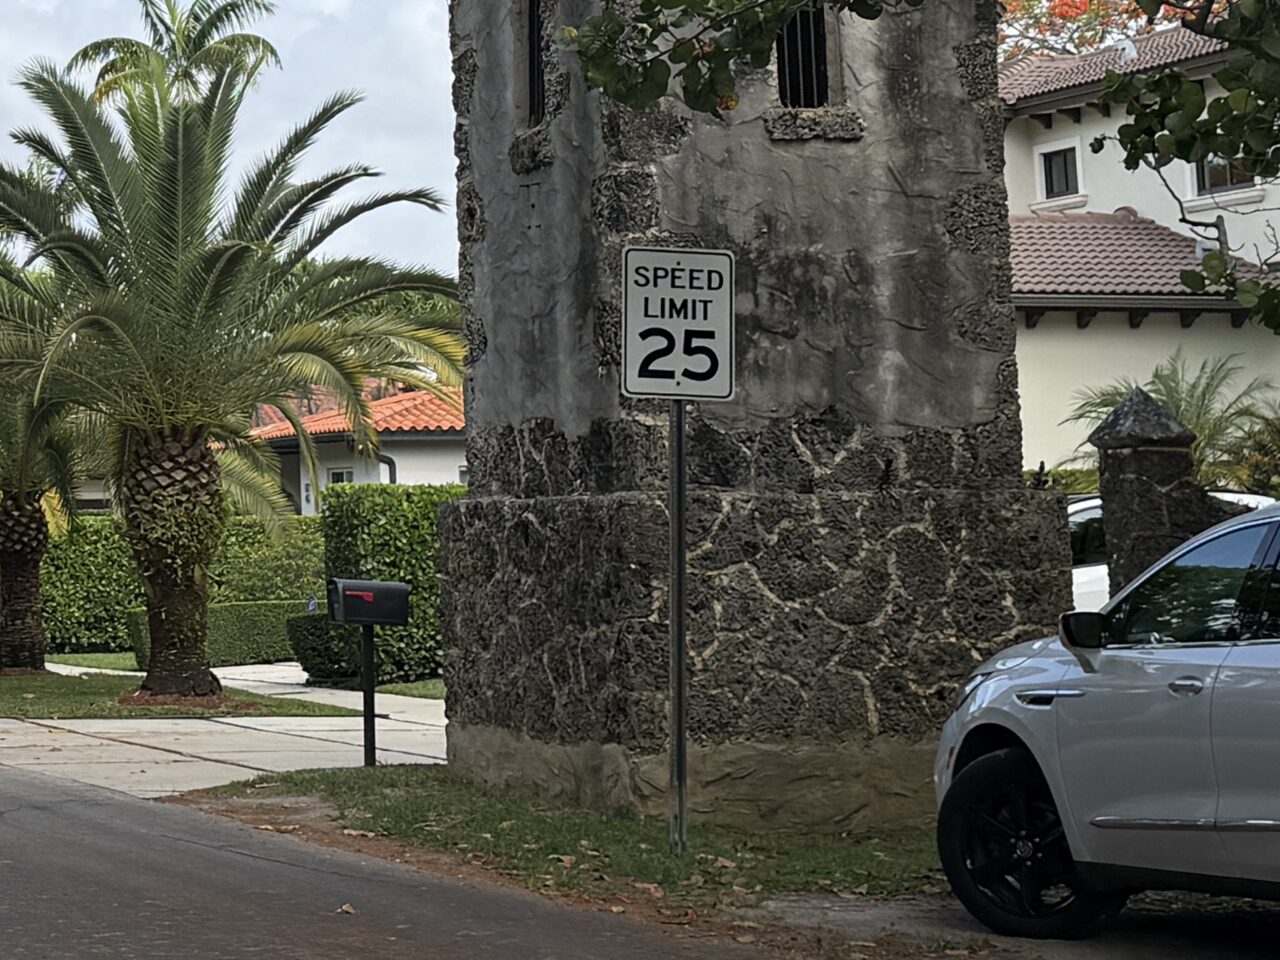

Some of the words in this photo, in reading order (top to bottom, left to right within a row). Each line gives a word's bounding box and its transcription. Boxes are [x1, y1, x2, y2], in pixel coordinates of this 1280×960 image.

[634, 266, 724, 291] SPEED
[644, 296, 713, 321] LIMIT
[638, 327, 720, 382] 25
